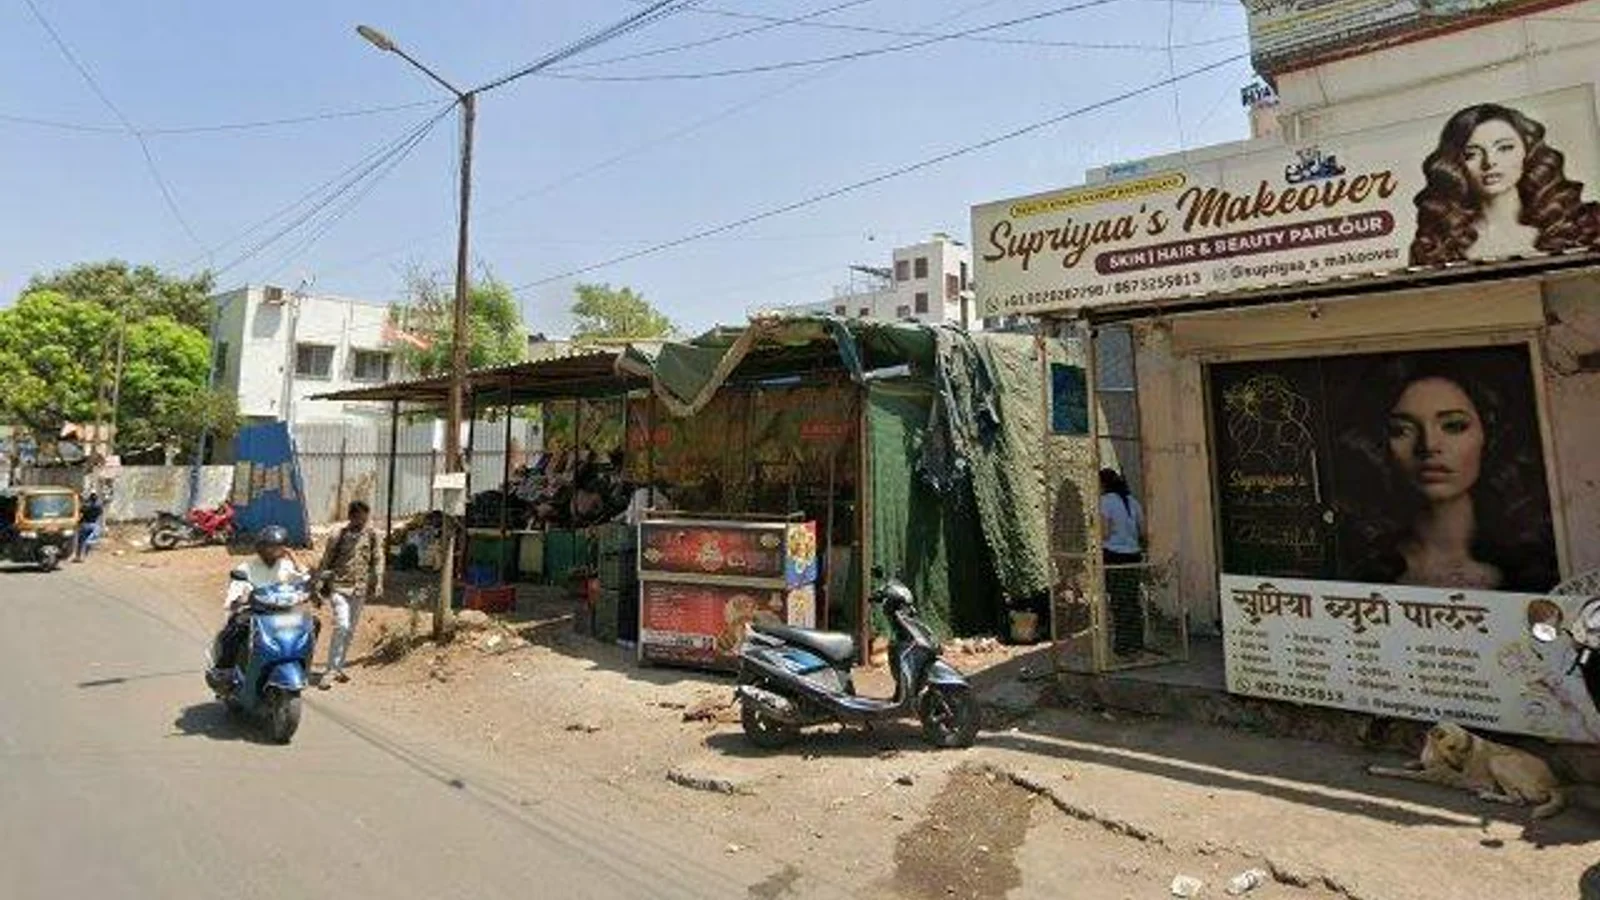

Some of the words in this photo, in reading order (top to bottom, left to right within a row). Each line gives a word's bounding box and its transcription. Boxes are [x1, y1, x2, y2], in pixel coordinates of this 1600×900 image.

[984, 203, 1169, 270] Supriyaa's
[1175, 170, 1398, 232] Makeover
[1109, 252, 1147, 269] SKIN
[1156, 244, 1196, 262] HAIR
[1200, 242, 1212, 256] &
[1215, 230, 1285, 252] BEAUTY
[1289, 216, 1384, 242] PARLOUR
